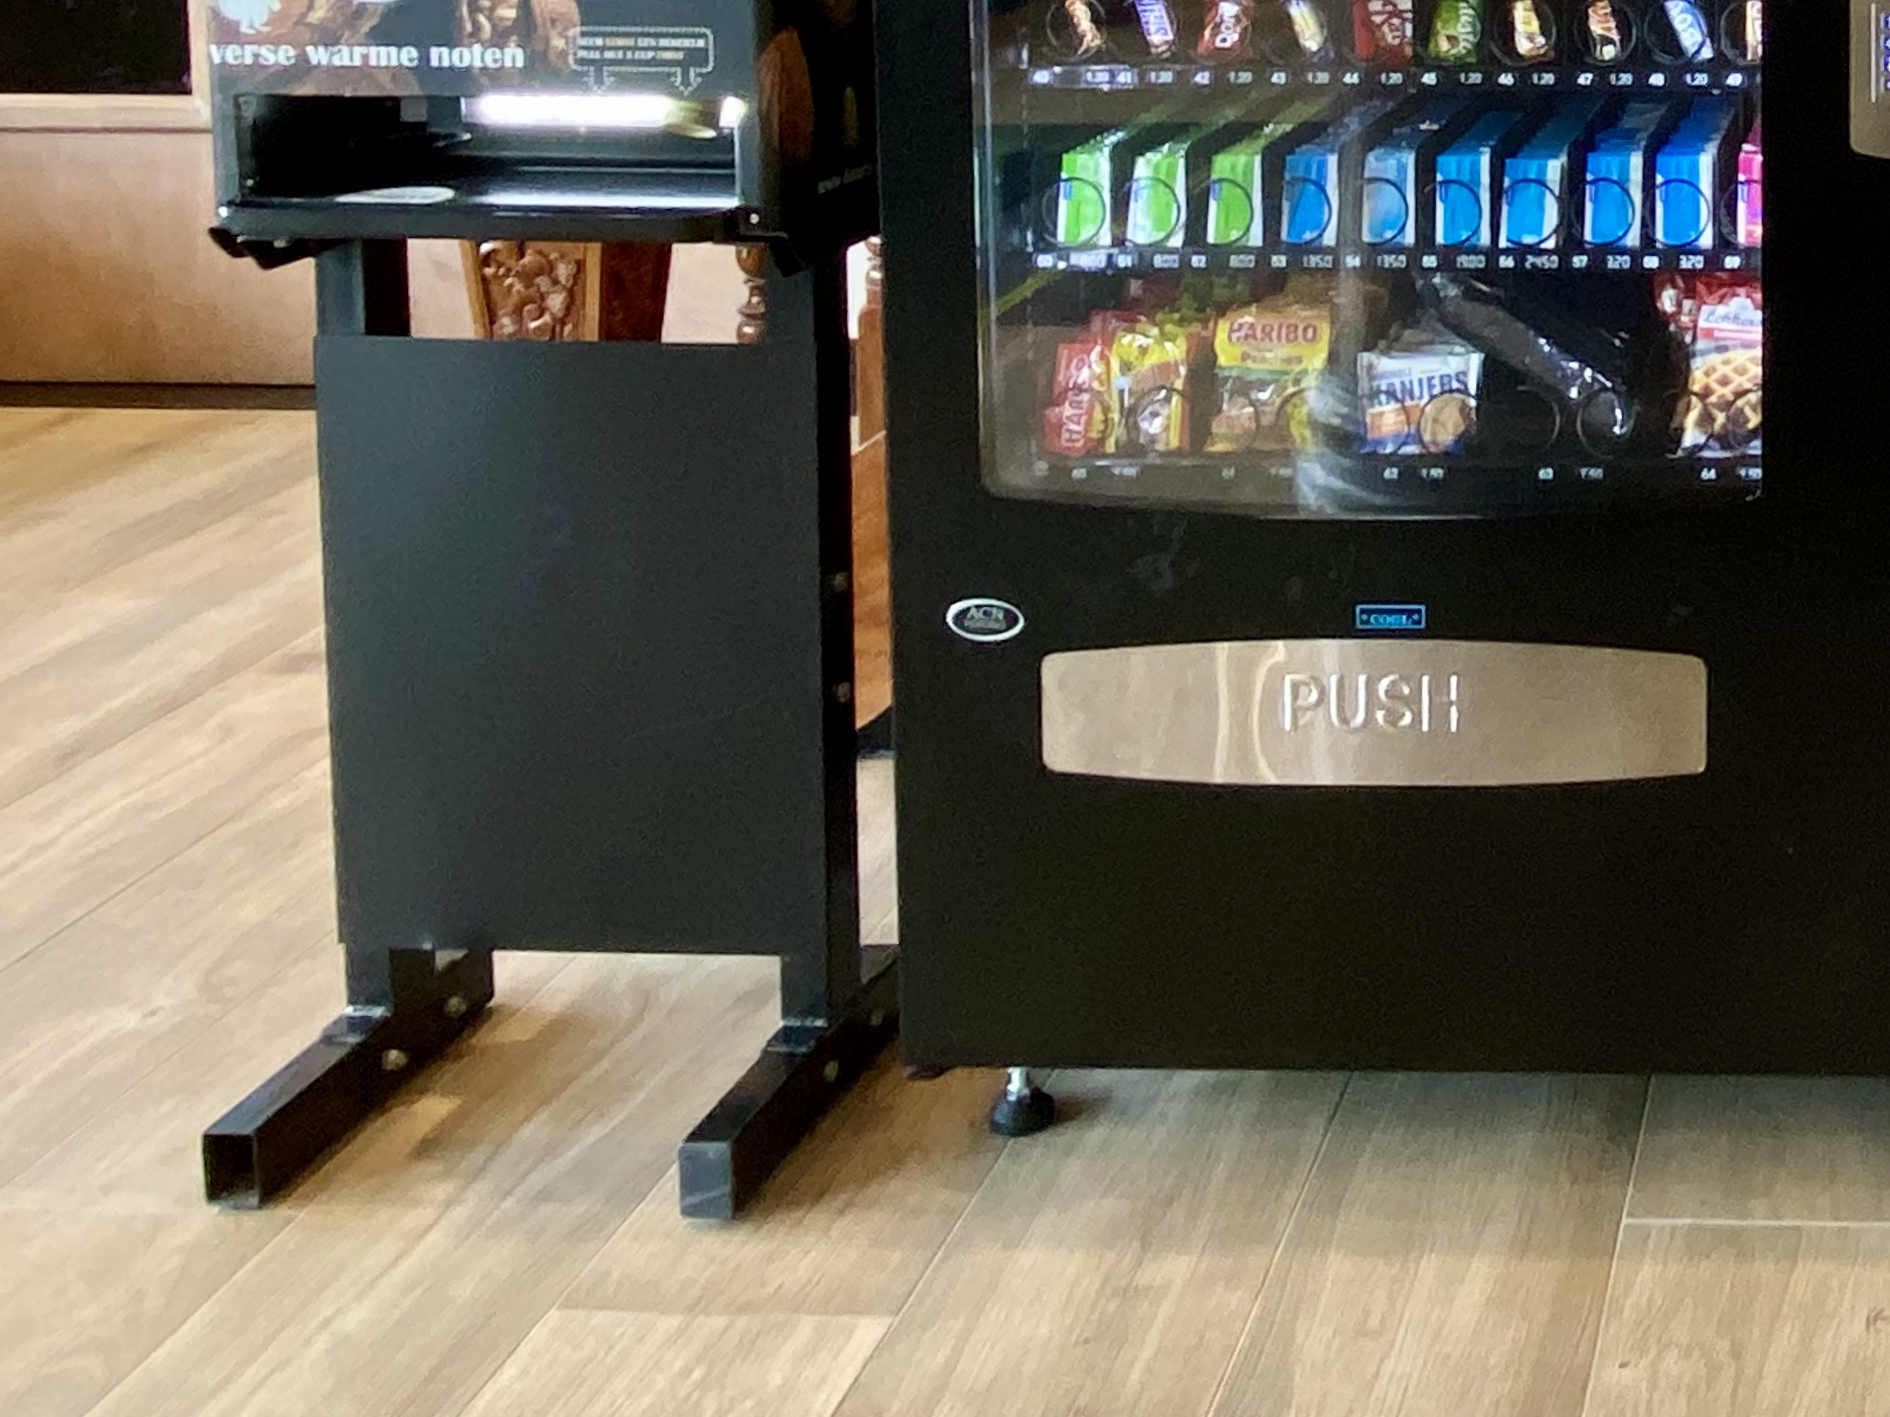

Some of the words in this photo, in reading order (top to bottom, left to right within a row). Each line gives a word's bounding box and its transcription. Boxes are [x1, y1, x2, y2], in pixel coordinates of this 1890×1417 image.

[209, 43, 295, 69] verse
[304, 45, 419, 69] warme
[429, 42, 524, 70] noten
[1229, 320, 1318, 344] HARIBO
[1281, 673, 1460, 733] PUSH
